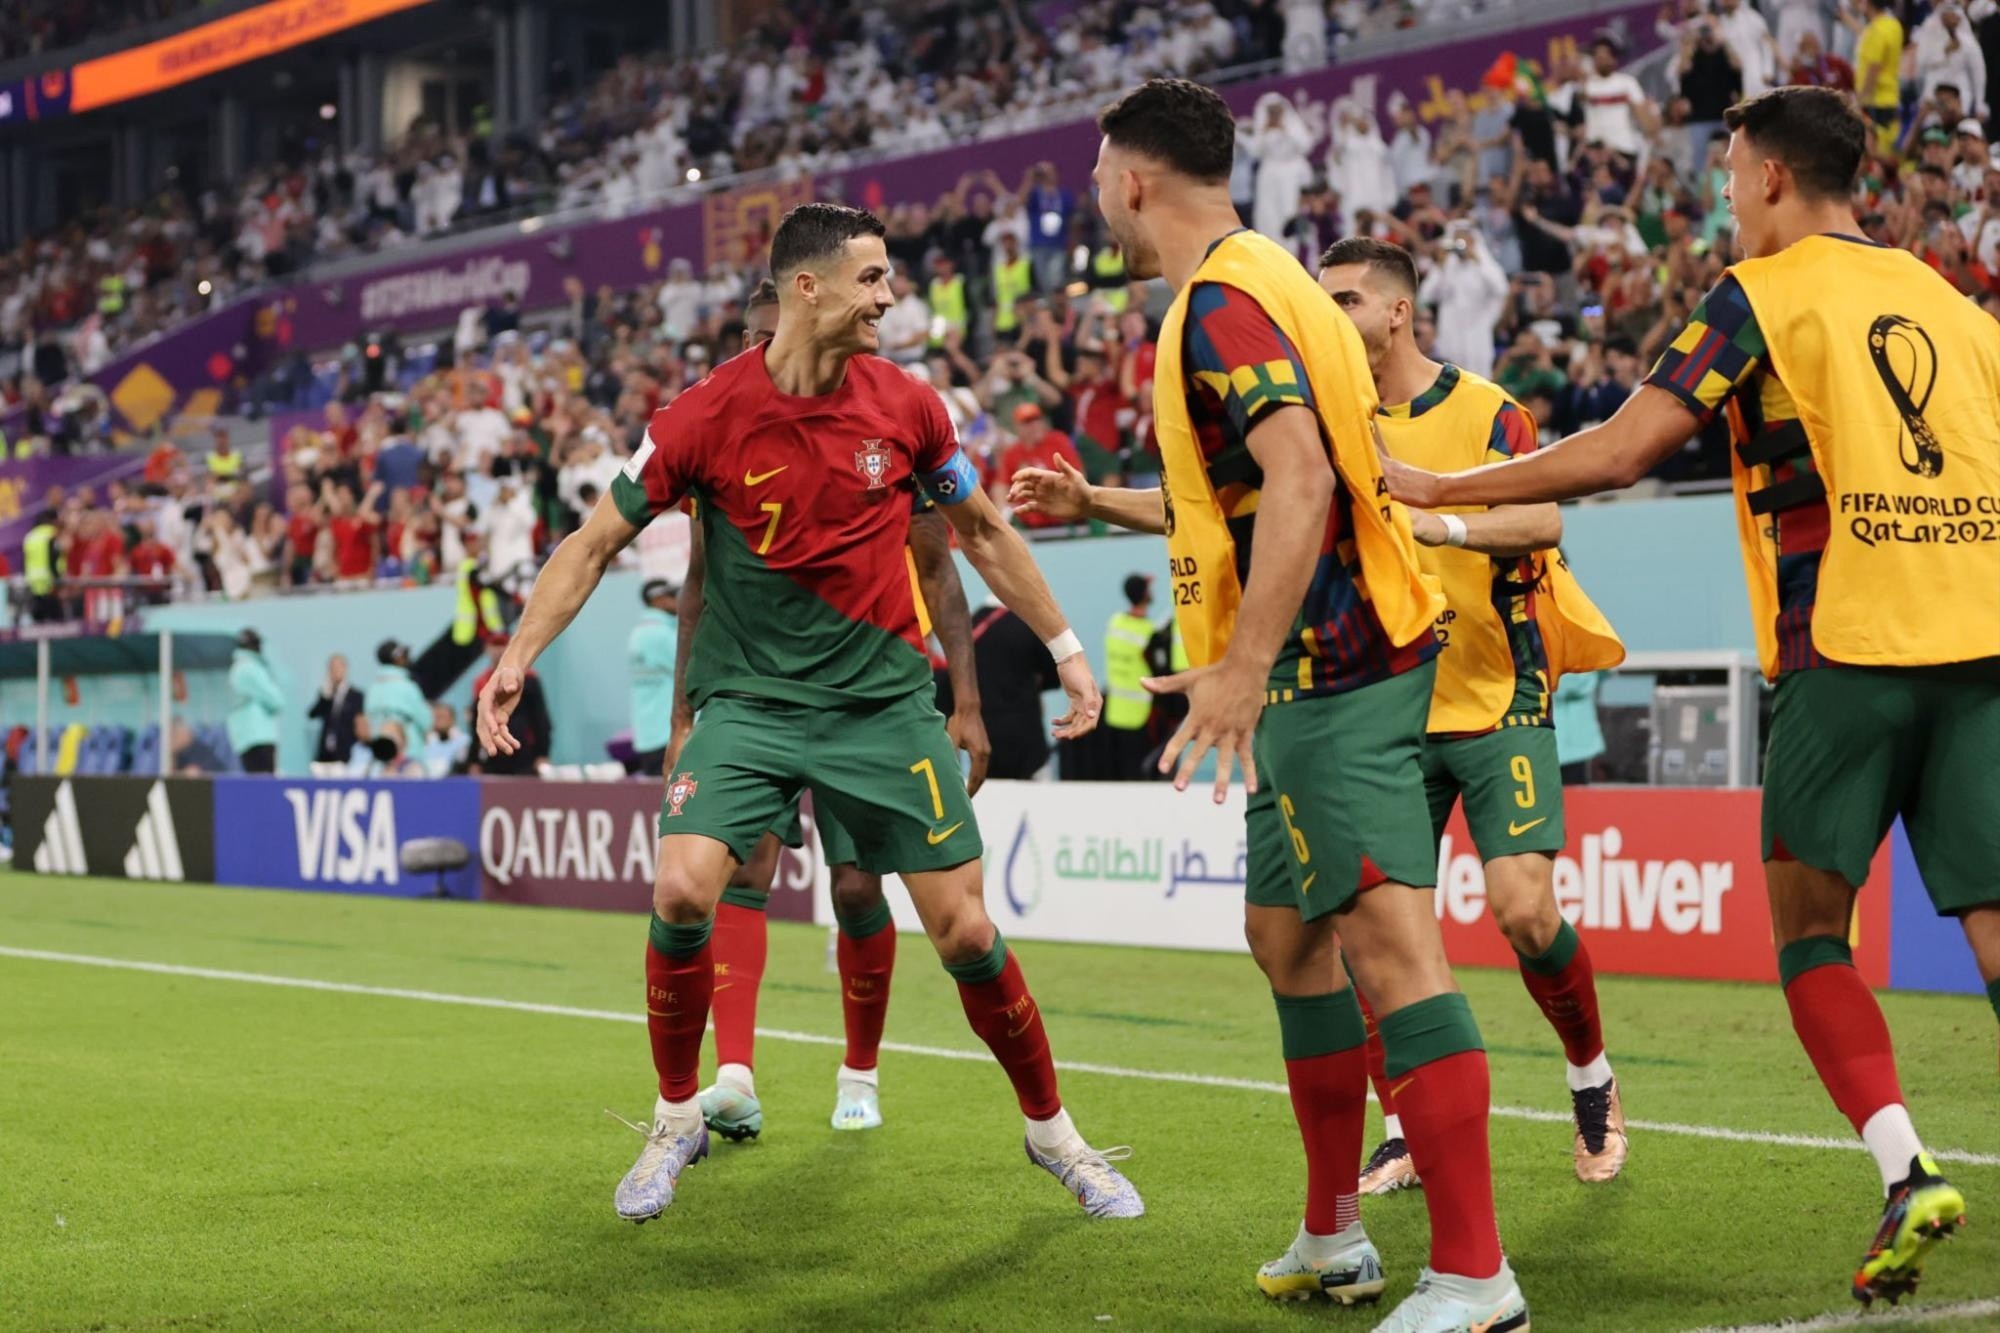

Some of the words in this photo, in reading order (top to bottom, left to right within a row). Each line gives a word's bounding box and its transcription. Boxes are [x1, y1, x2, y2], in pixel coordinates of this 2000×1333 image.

[757, 502, 782, 555] 7
[1840, 493, 1891, 513] FIFA
[1892, 495, 1972, 517] WORLD
[1977, 496, 2000, 515] CU
[1850, 517, 2000, 548] Qatar202
[1169, 556, 1198, 577] RLD
[1435, 609, 1457, 625] UP
[910, 758, 944, 820] 7
[1510, 755, 1536, 808] 9
[284, 787, 399, 885] VISA
[480, 807, 616, 885] QATAR
[1280, 793, 1310, 865] 6
[1055, 836, 1163, 882] للطاقة
[1553, 827, 1734, 934] eliver
[714, 963, 730, 976] PF
